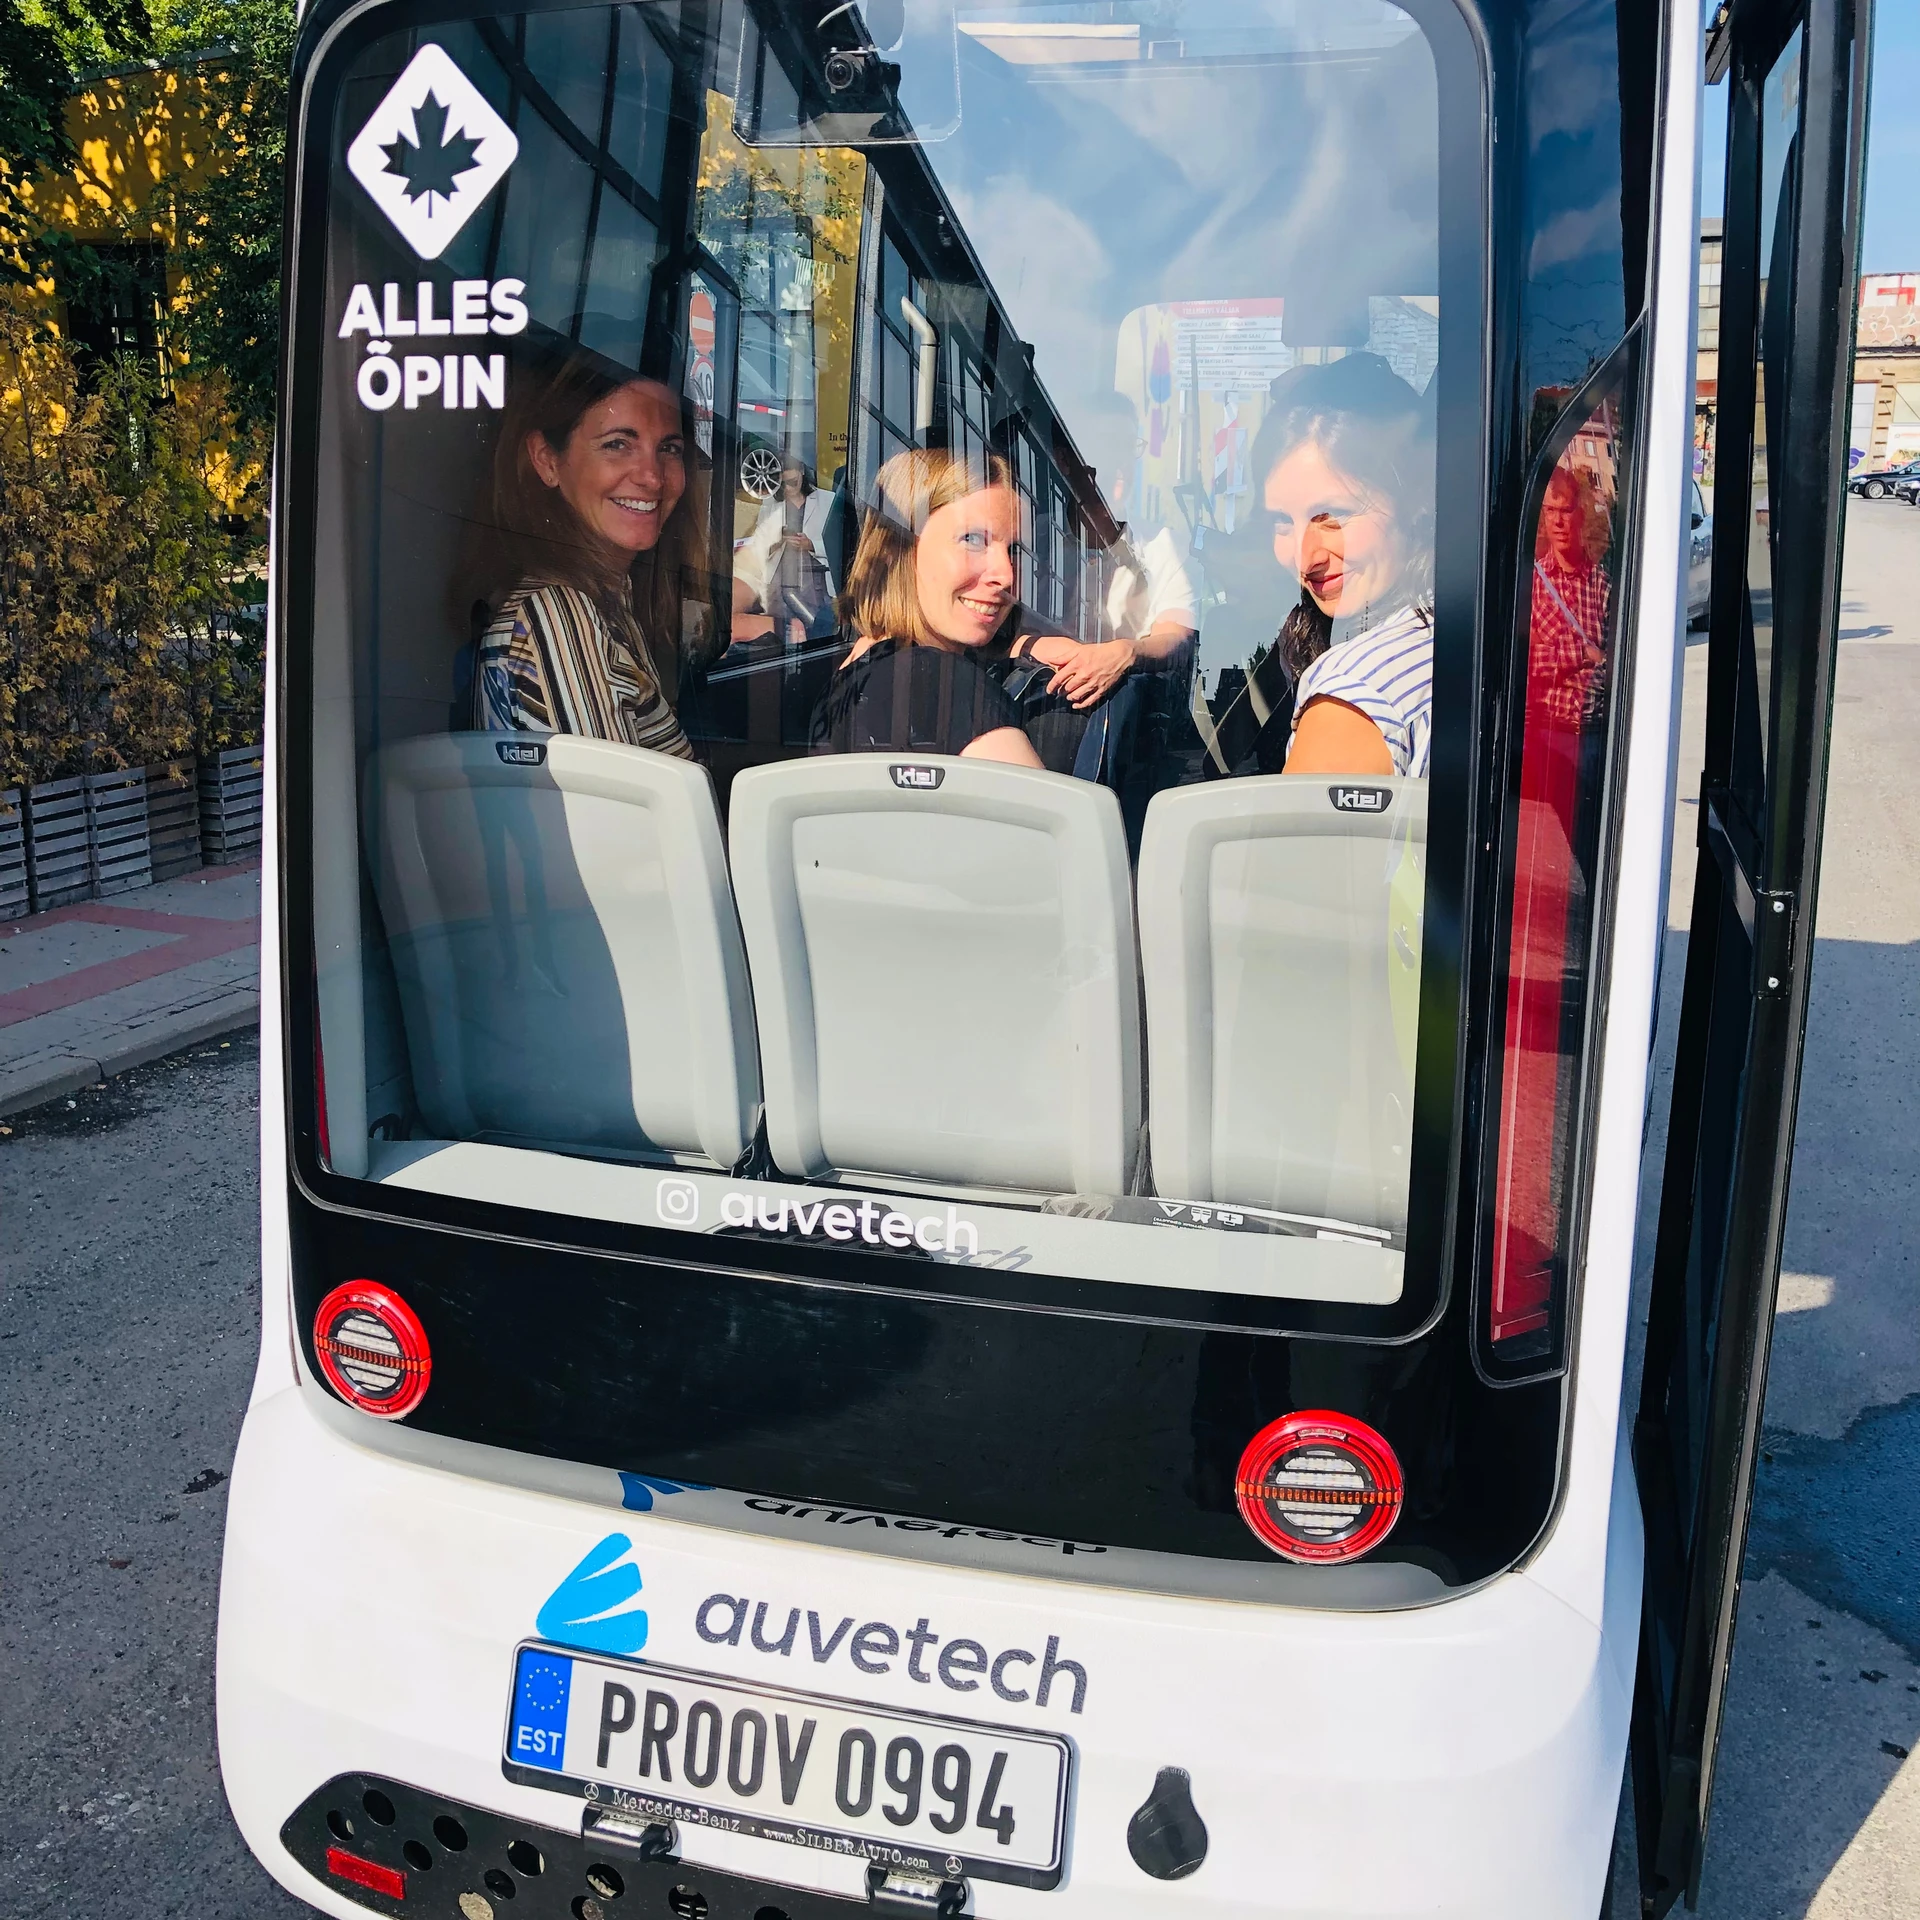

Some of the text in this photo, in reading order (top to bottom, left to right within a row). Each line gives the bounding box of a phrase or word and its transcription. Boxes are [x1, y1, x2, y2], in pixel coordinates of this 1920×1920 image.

[338, 277, 529, 338] ALLES
[357, 340, 505, 411] ÕPIN
[502, 744, 540, 763] kiel
[896, 767, 936, 787] kiel
[1337, 788, 1383, 809] kiel
[720, 1191, 979, 1256] auvetech
[695, 1592, 1088, 1714] auvetech
[516, 1724, 563, 1757] EST
[595, 1679, 1016, 1845] PROOV 0994
[611, 1789, 741, 1832] Mercedes-Benz
